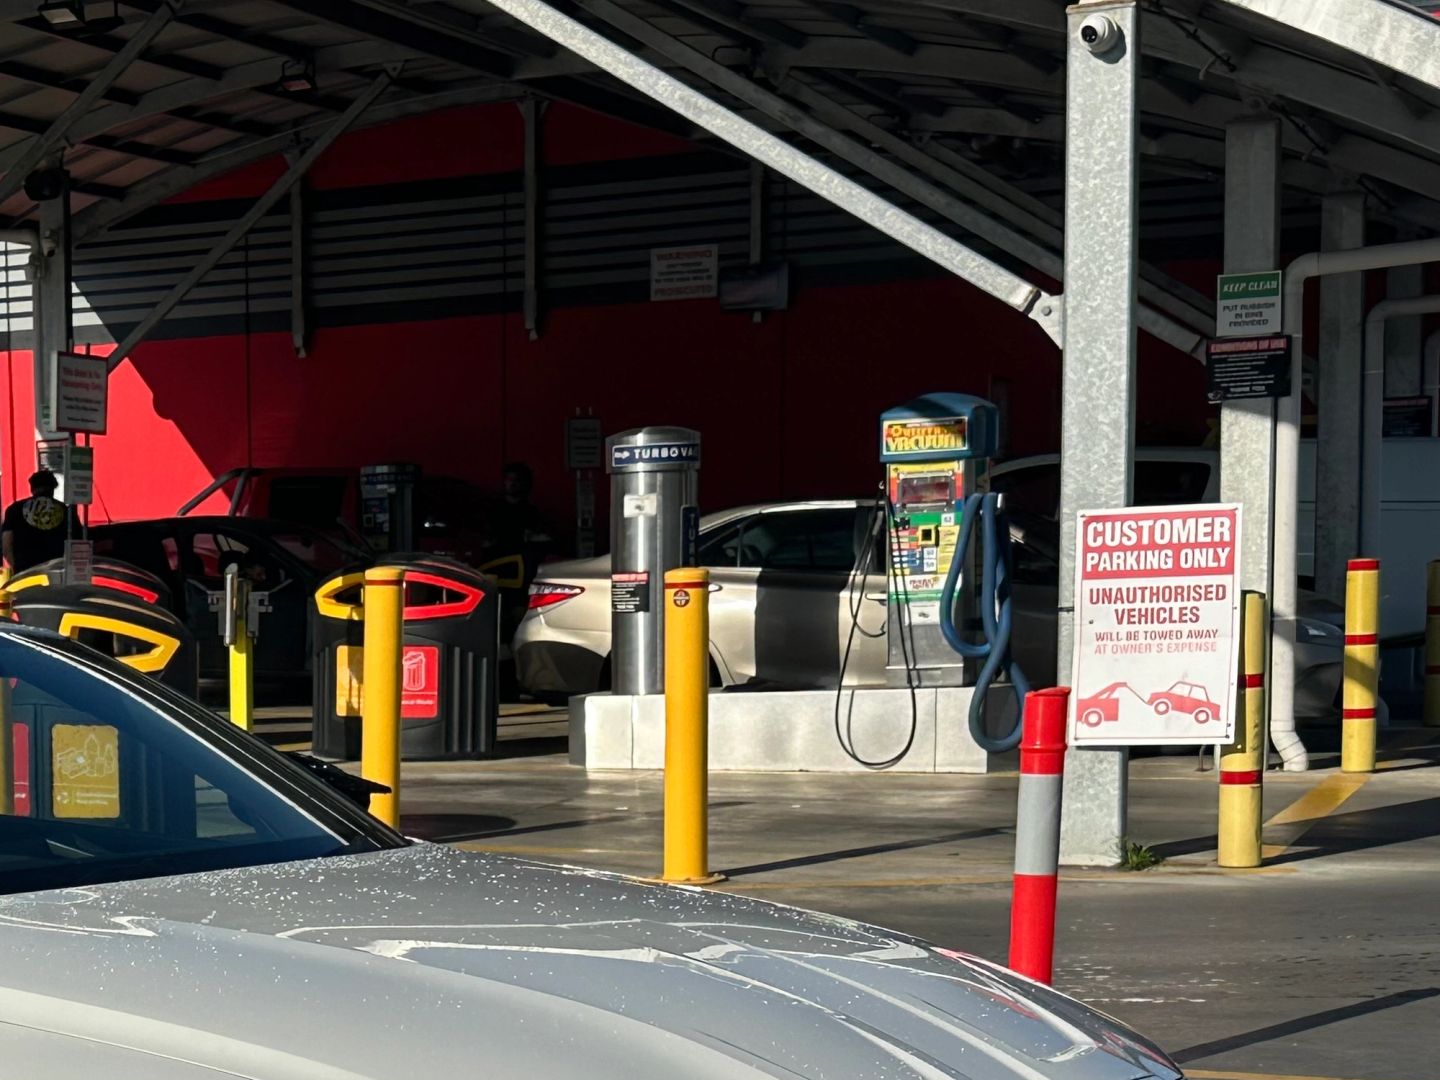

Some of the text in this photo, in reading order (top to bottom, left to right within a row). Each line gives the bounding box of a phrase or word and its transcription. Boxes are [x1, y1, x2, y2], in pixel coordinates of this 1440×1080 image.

[1222, 283, 1246, 293] KEEP
[1087, 517, 1231, 547] CUSTOMER
[1086, 547, 1231, 573] PARKING ONLY
[1089, 584, 1227, 605] UNAUTHORISED
[1114, 606, 1201, 626] VEHICLES
[1095, 629, 1219, 642] WILL BE TOWED AWAY
[1094, 641, 1217, 655] AT OWNER'S EXPENSE
